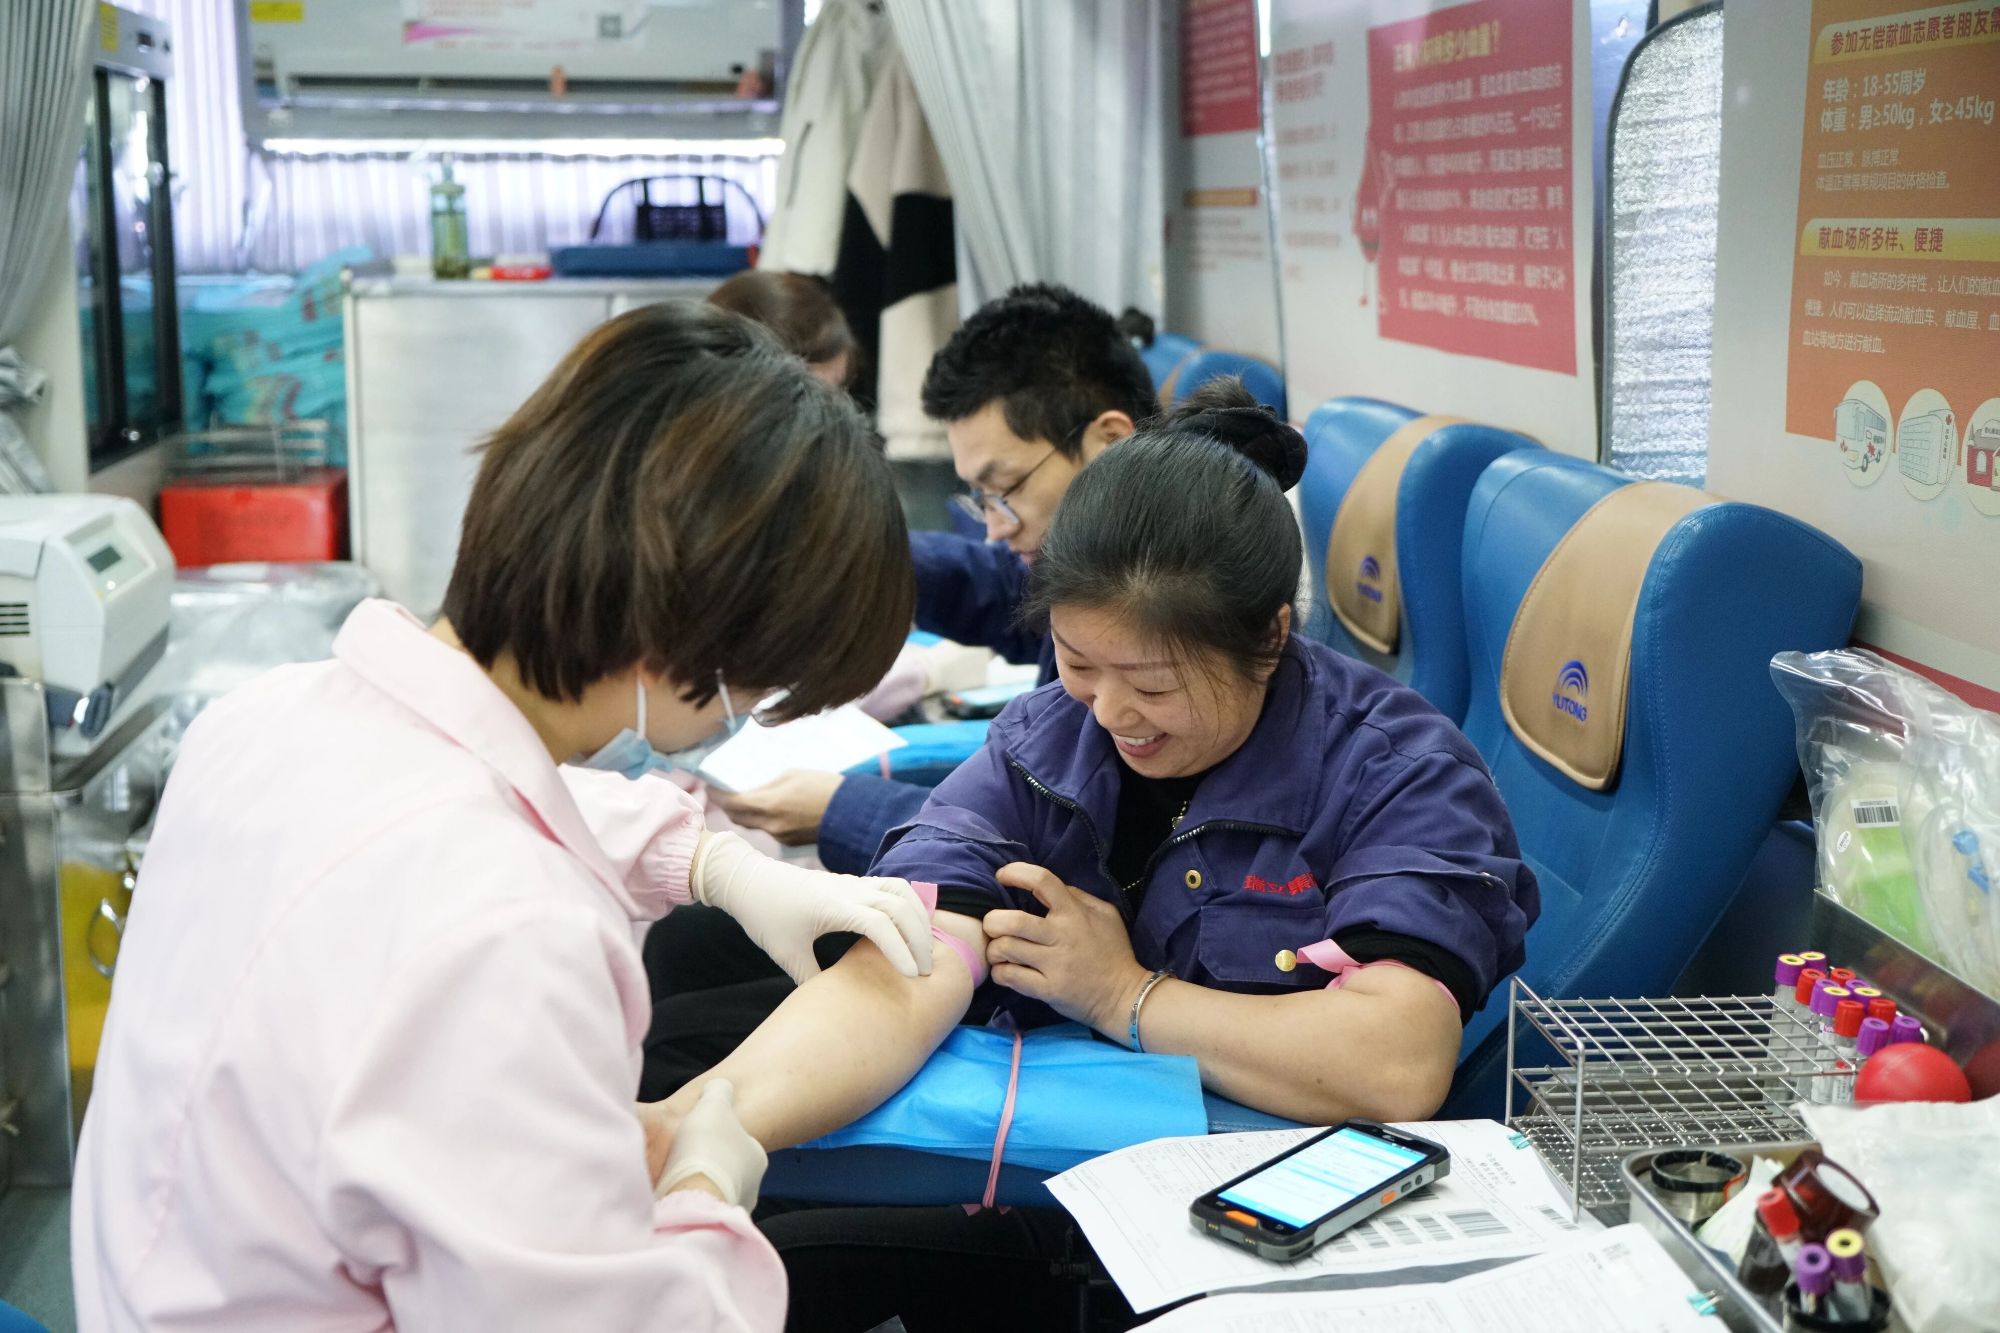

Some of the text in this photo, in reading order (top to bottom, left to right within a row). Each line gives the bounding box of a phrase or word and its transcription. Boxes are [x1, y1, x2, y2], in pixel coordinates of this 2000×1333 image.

[1818, 225, 1944, 253] 献血场所多样、便捷
[1552, 690, 1588, 722] YUTONG
